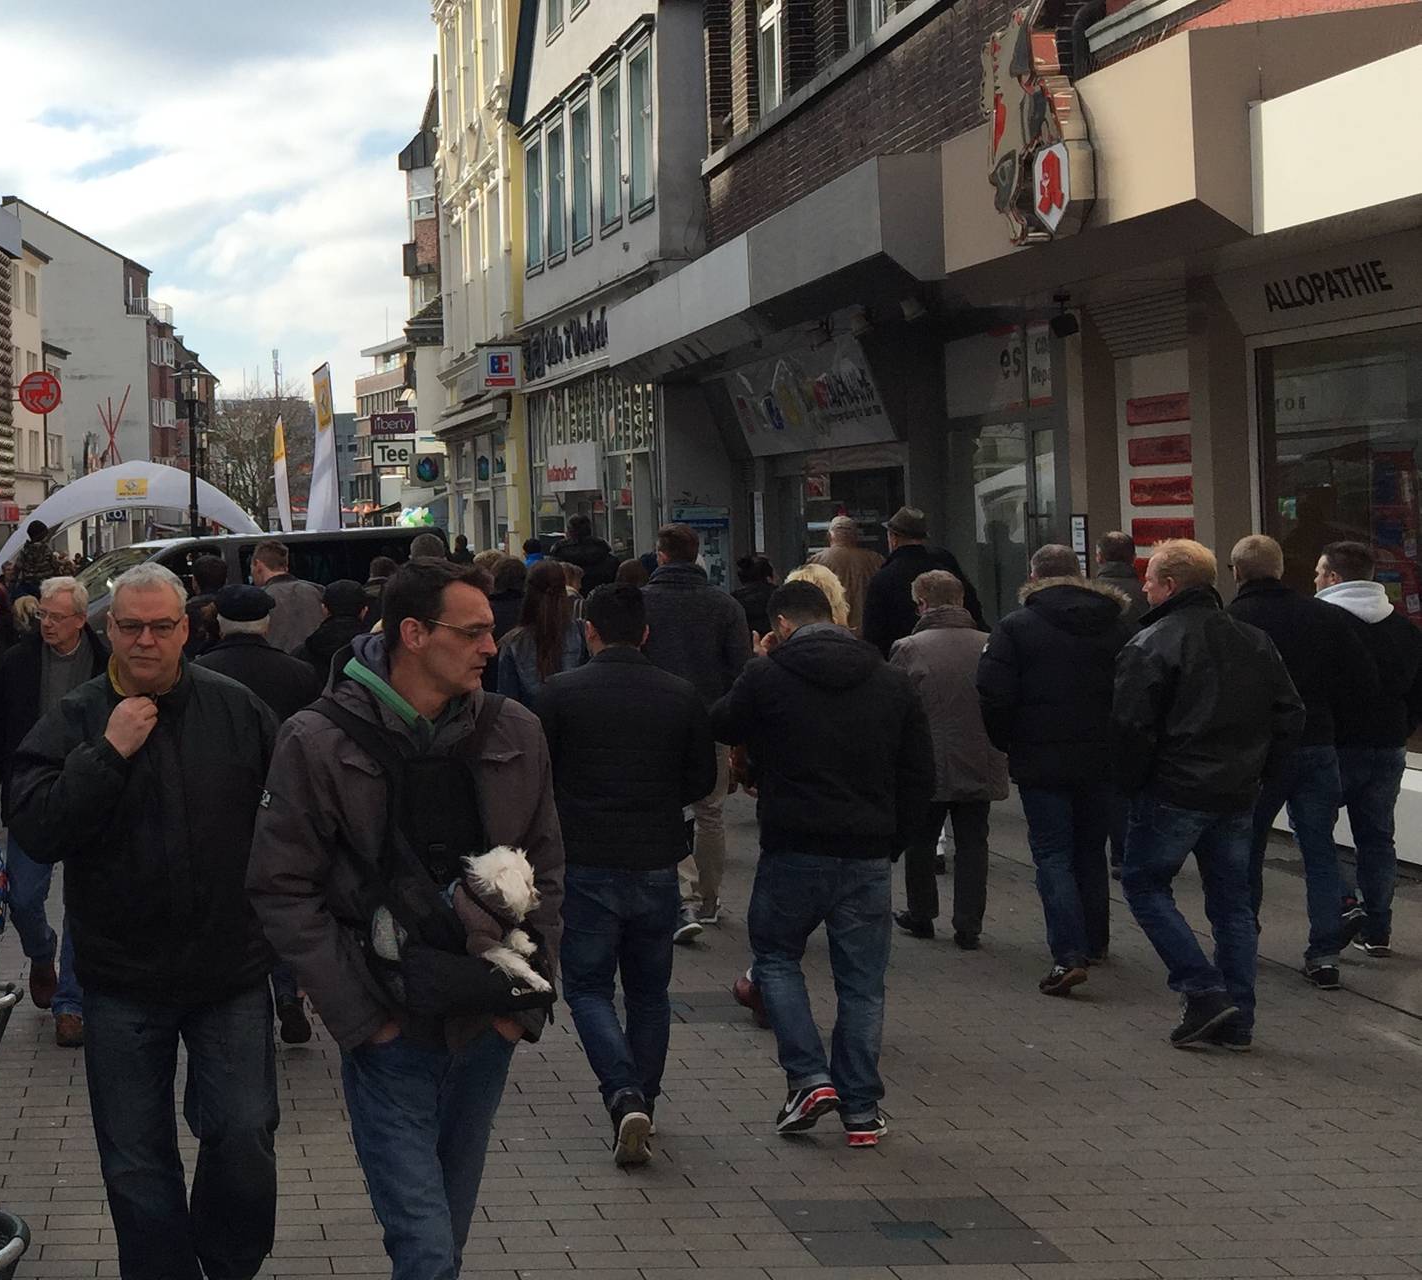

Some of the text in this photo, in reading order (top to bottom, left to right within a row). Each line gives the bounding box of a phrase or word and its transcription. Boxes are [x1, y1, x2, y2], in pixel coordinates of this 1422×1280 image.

[1264, 260, 1393, 312] ALLOPATHIE
[373, 416, 411, 430] liberty
[377, 445, 408, 463] Tee
